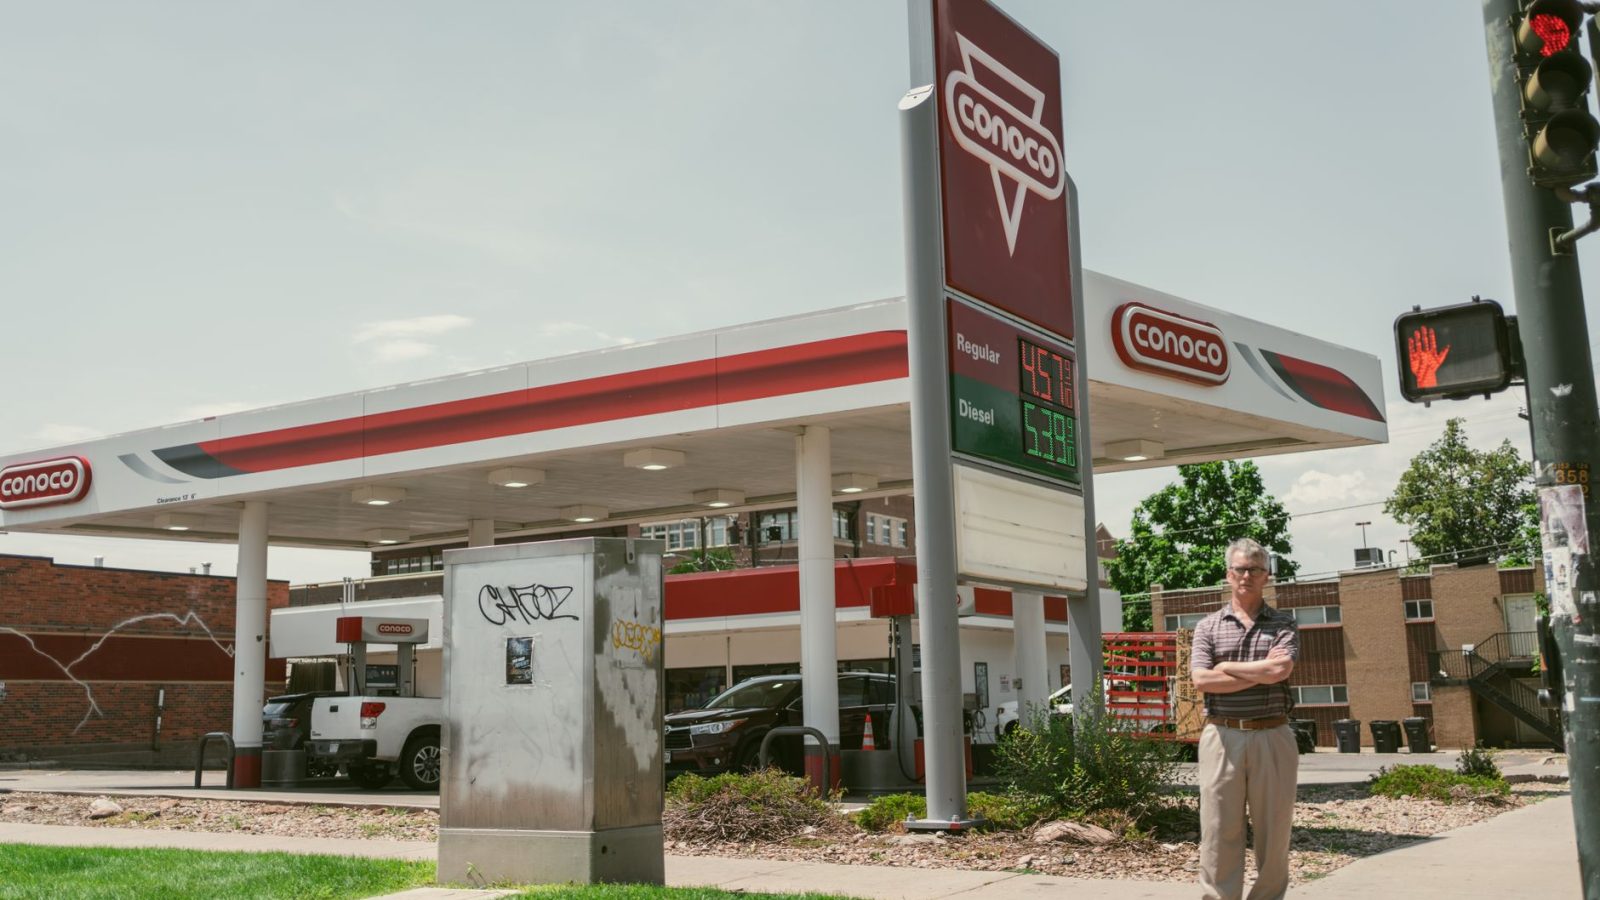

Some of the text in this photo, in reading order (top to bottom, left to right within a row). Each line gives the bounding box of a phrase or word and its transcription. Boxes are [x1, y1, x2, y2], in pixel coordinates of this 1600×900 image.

[956, 332, 1001, 365] Regular
[959, 398, 995, 426] Diesel
[1555, 469, 1588, 484] 358
